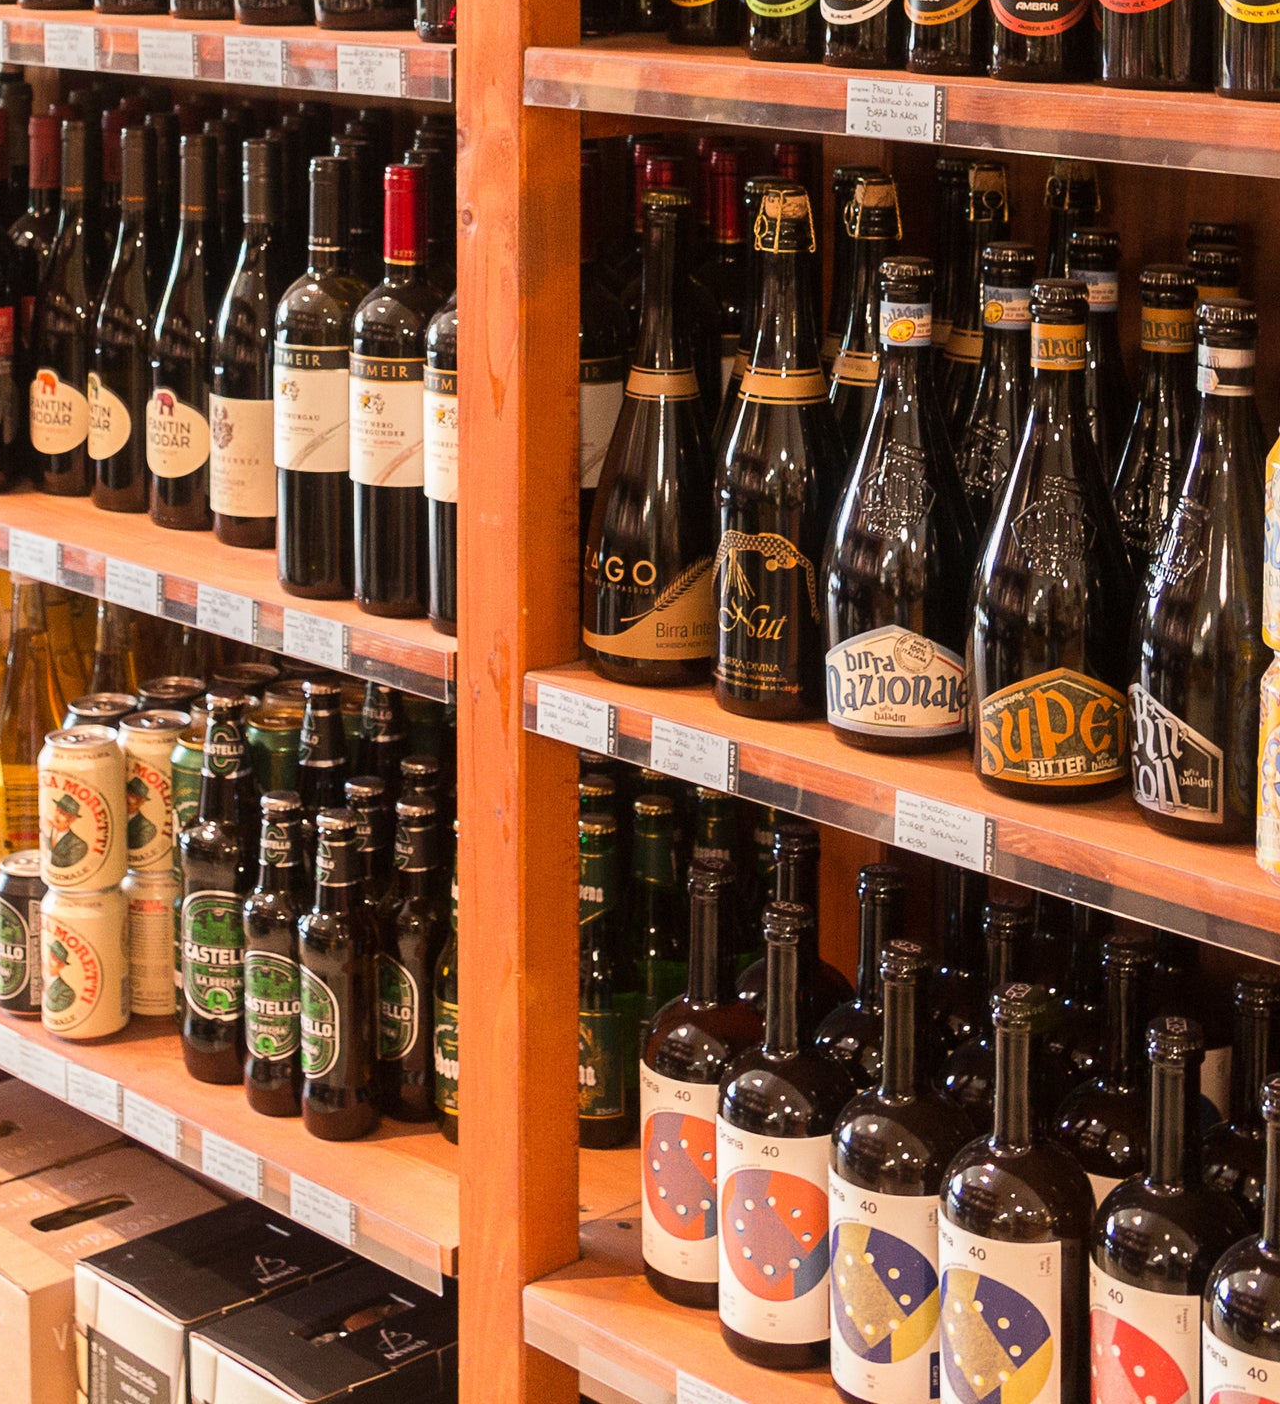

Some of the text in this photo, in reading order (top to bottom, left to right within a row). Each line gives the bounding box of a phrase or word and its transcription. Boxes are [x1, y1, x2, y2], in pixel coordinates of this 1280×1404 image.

[1016, 2, 1058, 11] AMBRIA
[277, 353, 320, 367] TMEIR
[719, 596, 787, 640] Nut
[656, 622, 687, 638] Birra
[745, 660, 781, 673] DIVINA
[845, 650, 894, 674] birra
[827, 664, 969, 715] Nazionale
[874, 710, 906, 723] baladin
[1027, 756, 1087, 780] BITTER
[1180, 775, 1213, 788] baladin
[62, 779, 109, 857] MORETTI
[184, 942, 244, 965] CASTELL
[54, 929, 99, 1006] MORETTI
[301, 1017, 332, 1038] ELLO
[675, 1090, 691, 1102] 40
[761, 1146, 779, 1158] 40
[860, 1200, 877, 1214] 40
[969, 1245, 986, 1261] 40
[1108, 1287, 1123, 1304] 40
[1247, 1366, 1267, 1384] 40
